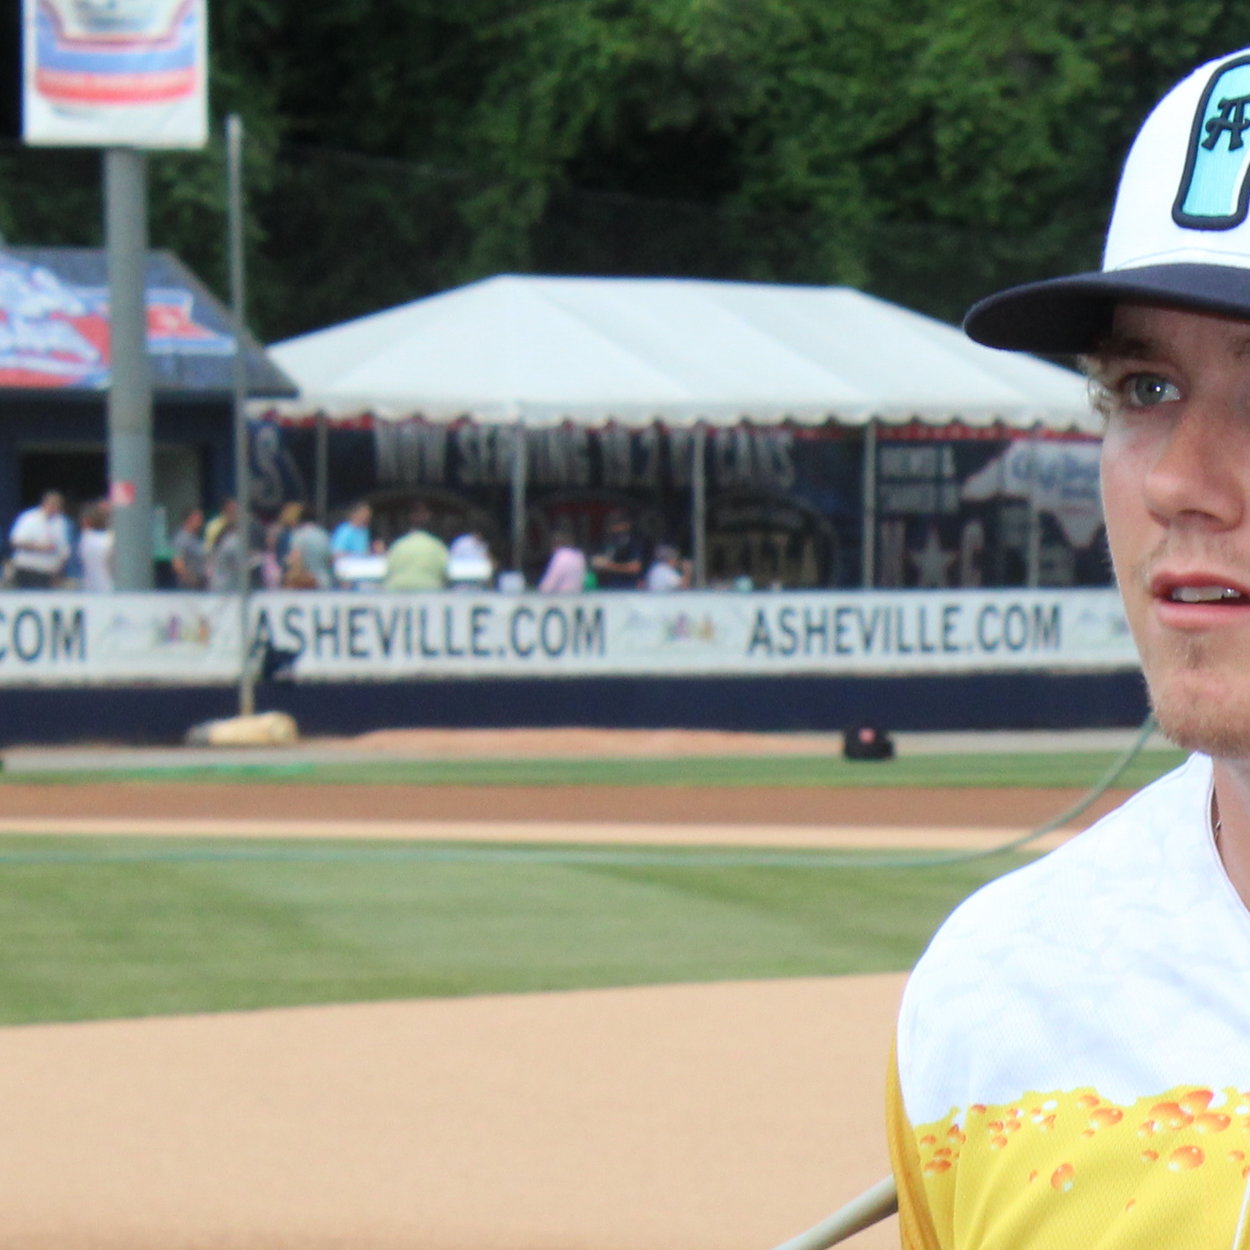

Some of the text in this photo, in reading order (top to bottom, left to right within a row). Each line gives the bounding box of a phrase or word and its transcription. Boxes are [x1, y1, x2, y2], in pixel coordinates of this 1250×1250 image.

[0, 608, 87, 662] OM
[251, 605, 607, 658] ASHEVILLE.COM
[747, 603, 1062, 656] ASHEVILLE.COM
